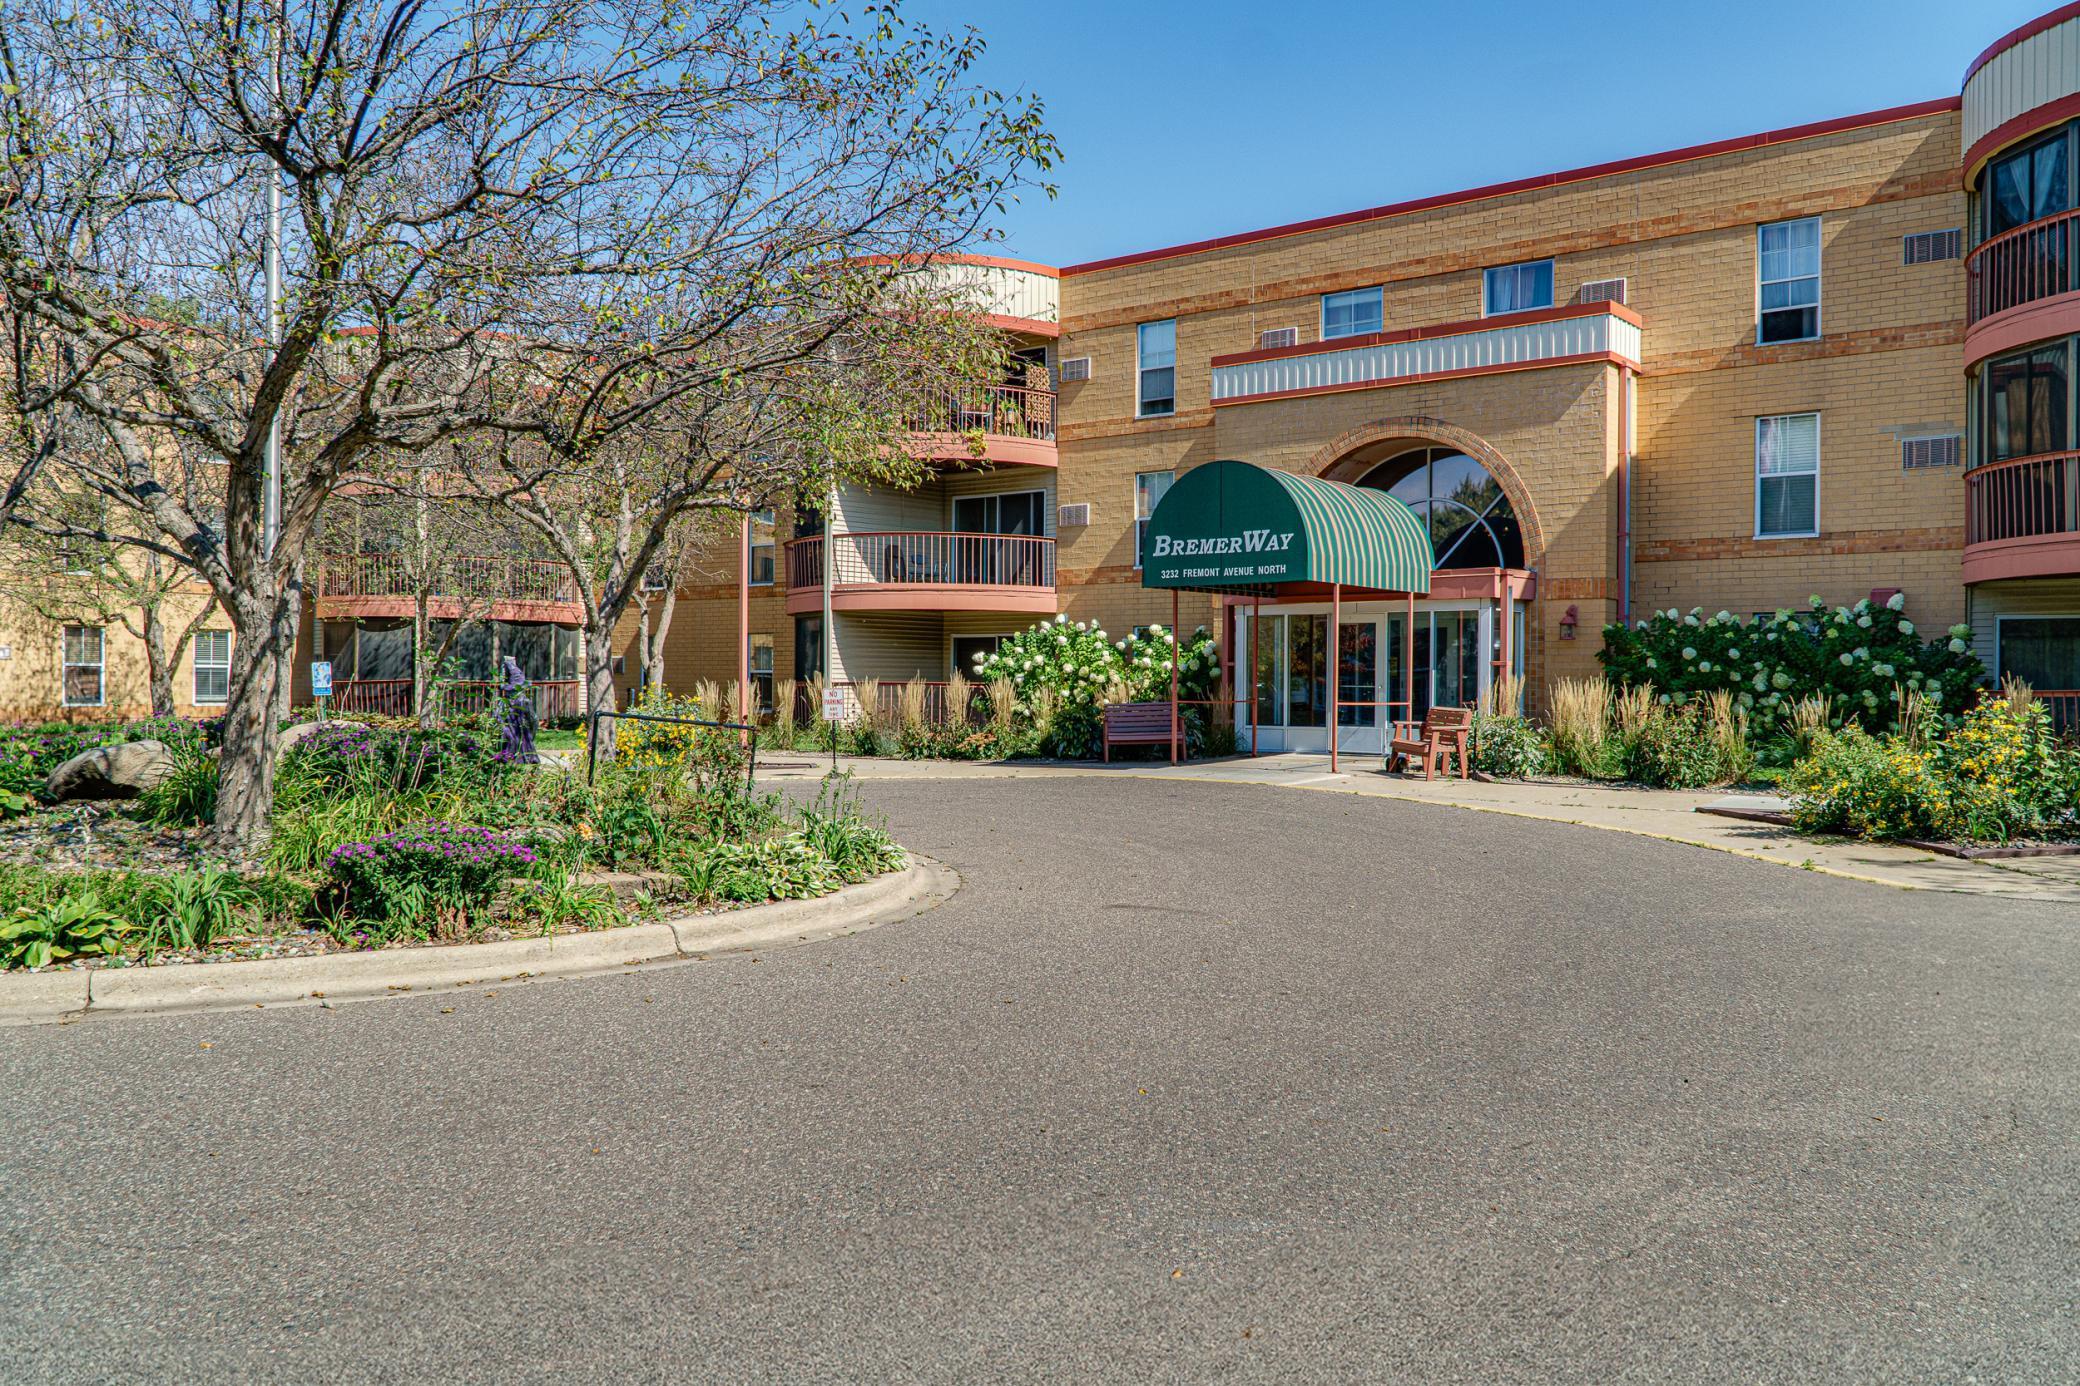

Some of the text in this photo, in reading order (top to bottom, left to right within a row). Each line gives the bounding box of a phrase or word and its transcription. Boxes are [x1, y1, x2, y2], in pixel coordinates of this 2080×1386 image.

[1161, 564, 1287, 579] 3232 FREMONT AVENUE NORTH
